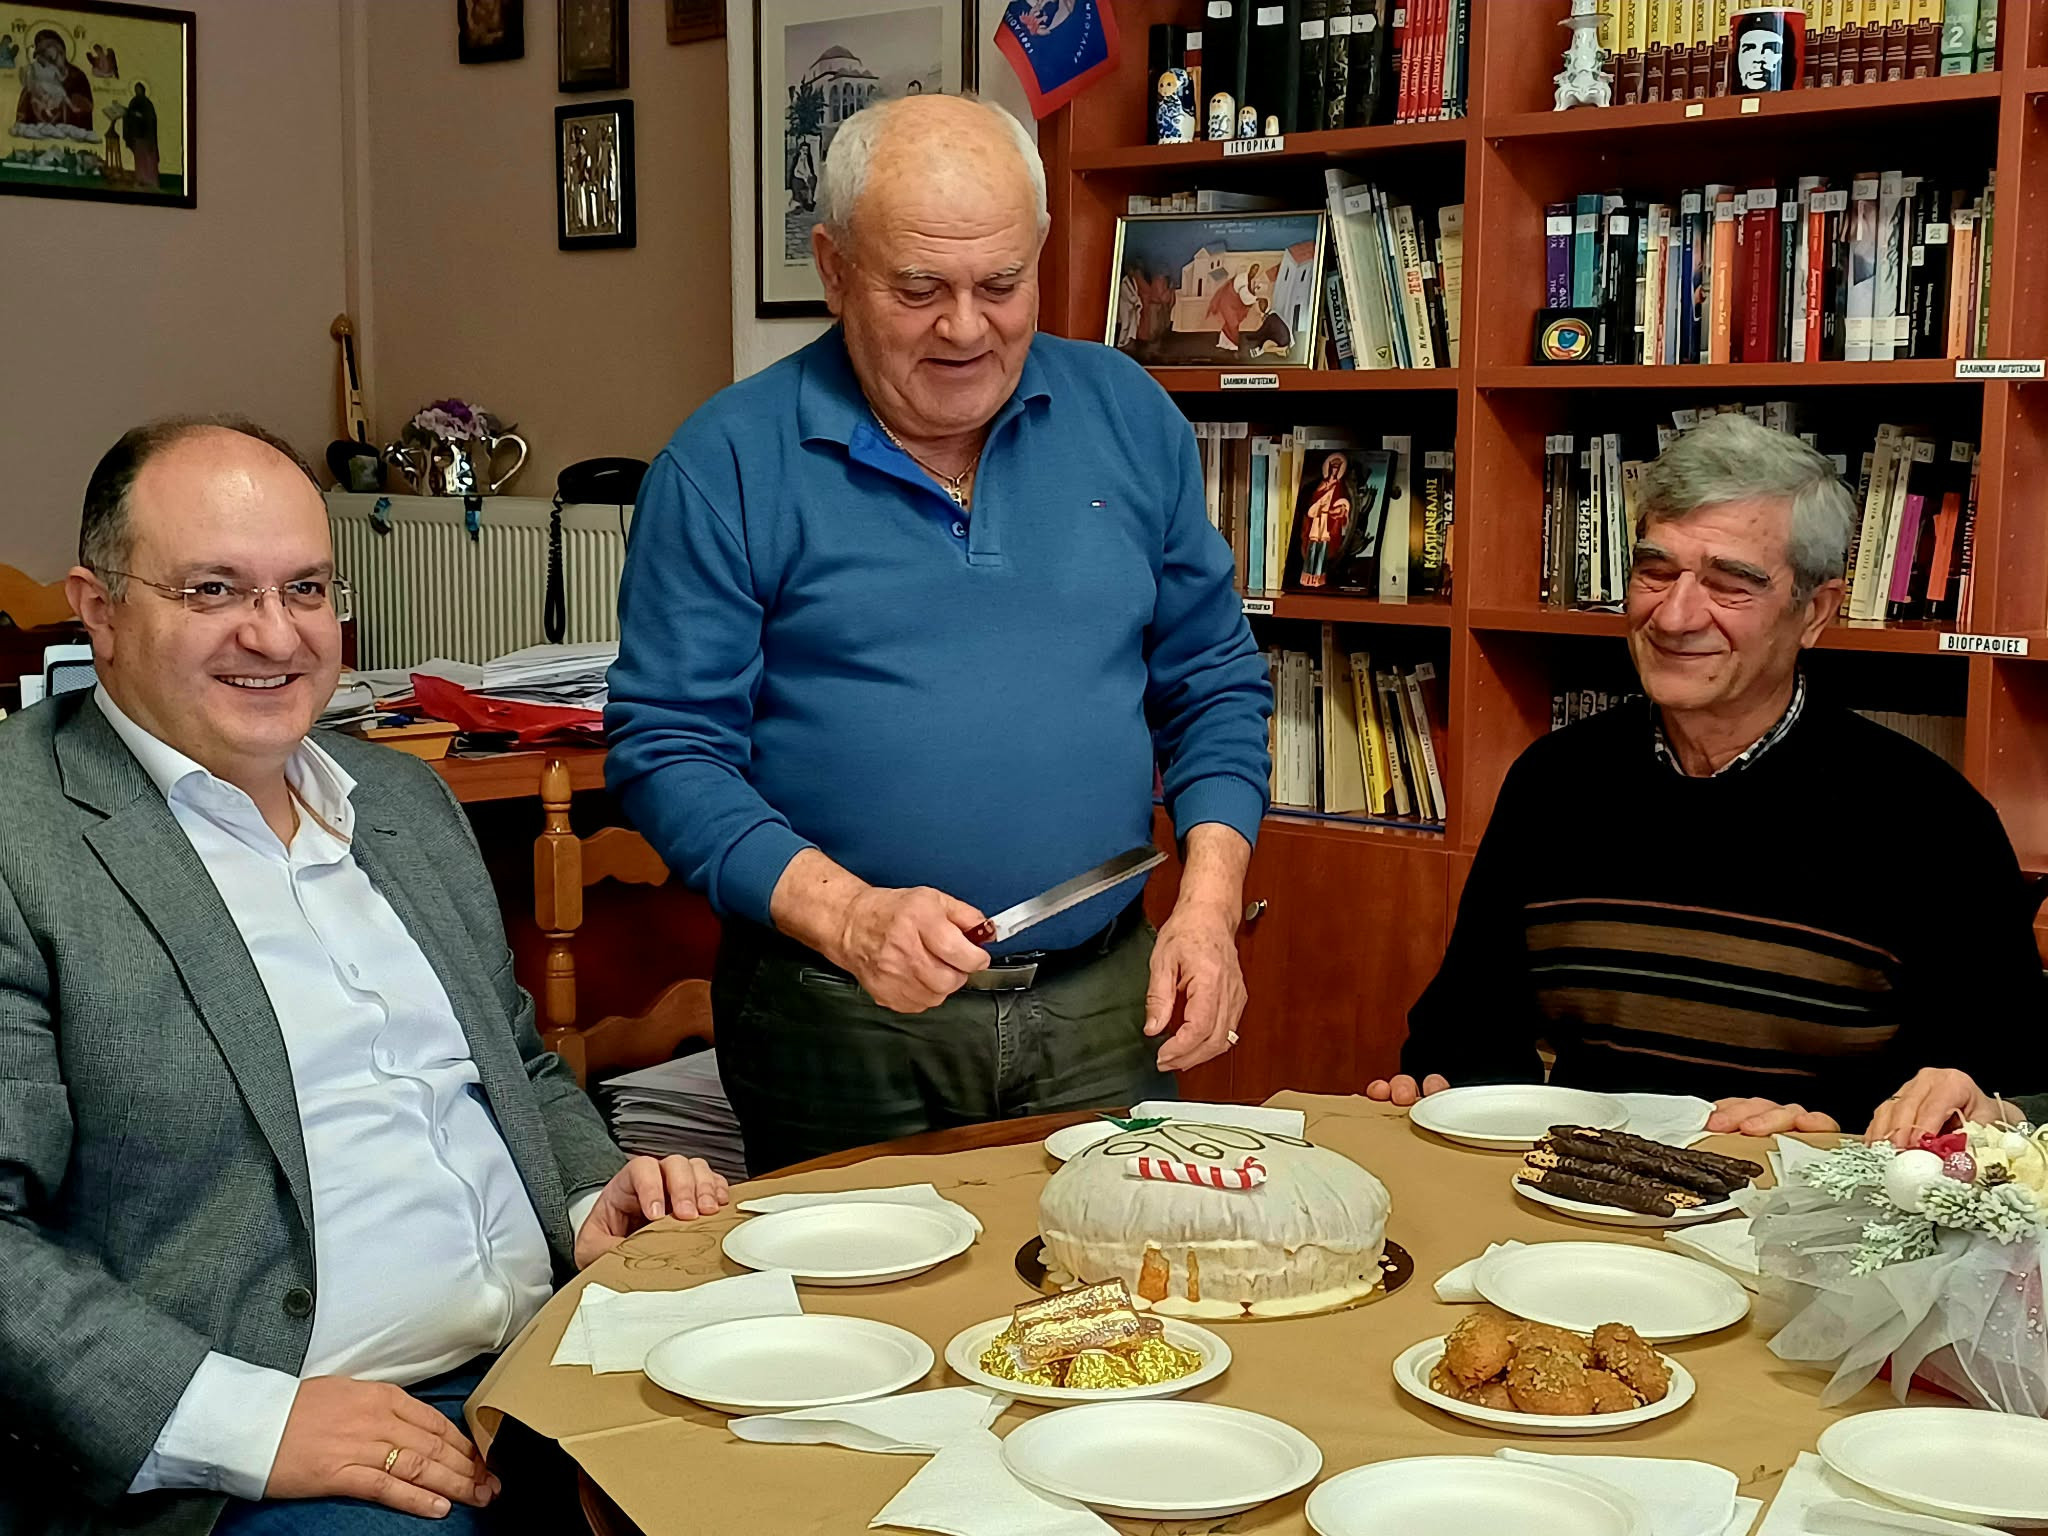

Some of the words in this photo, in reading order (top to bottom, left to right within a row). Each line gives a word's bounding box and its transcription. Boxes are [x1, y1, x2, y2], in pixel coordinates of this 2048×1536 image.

[1950, 25, 1964, 48] 2
[1985, 20, 1997, 42] 3
[1231, 139, 1276, 153] ΙΣΤΟΡΙΚΑ
[1422, 357, 1431, 367] 2
[1424, 478, 1438, 568] ΚΑΜΠΑΝΕΛΛΗΣ
[1578, 498, 1590, 555] ΣΕΦΕΡΗΣ
[1948, 636, 2020, 653] ΒΙΟΓΡΑΦΙΕΣ
